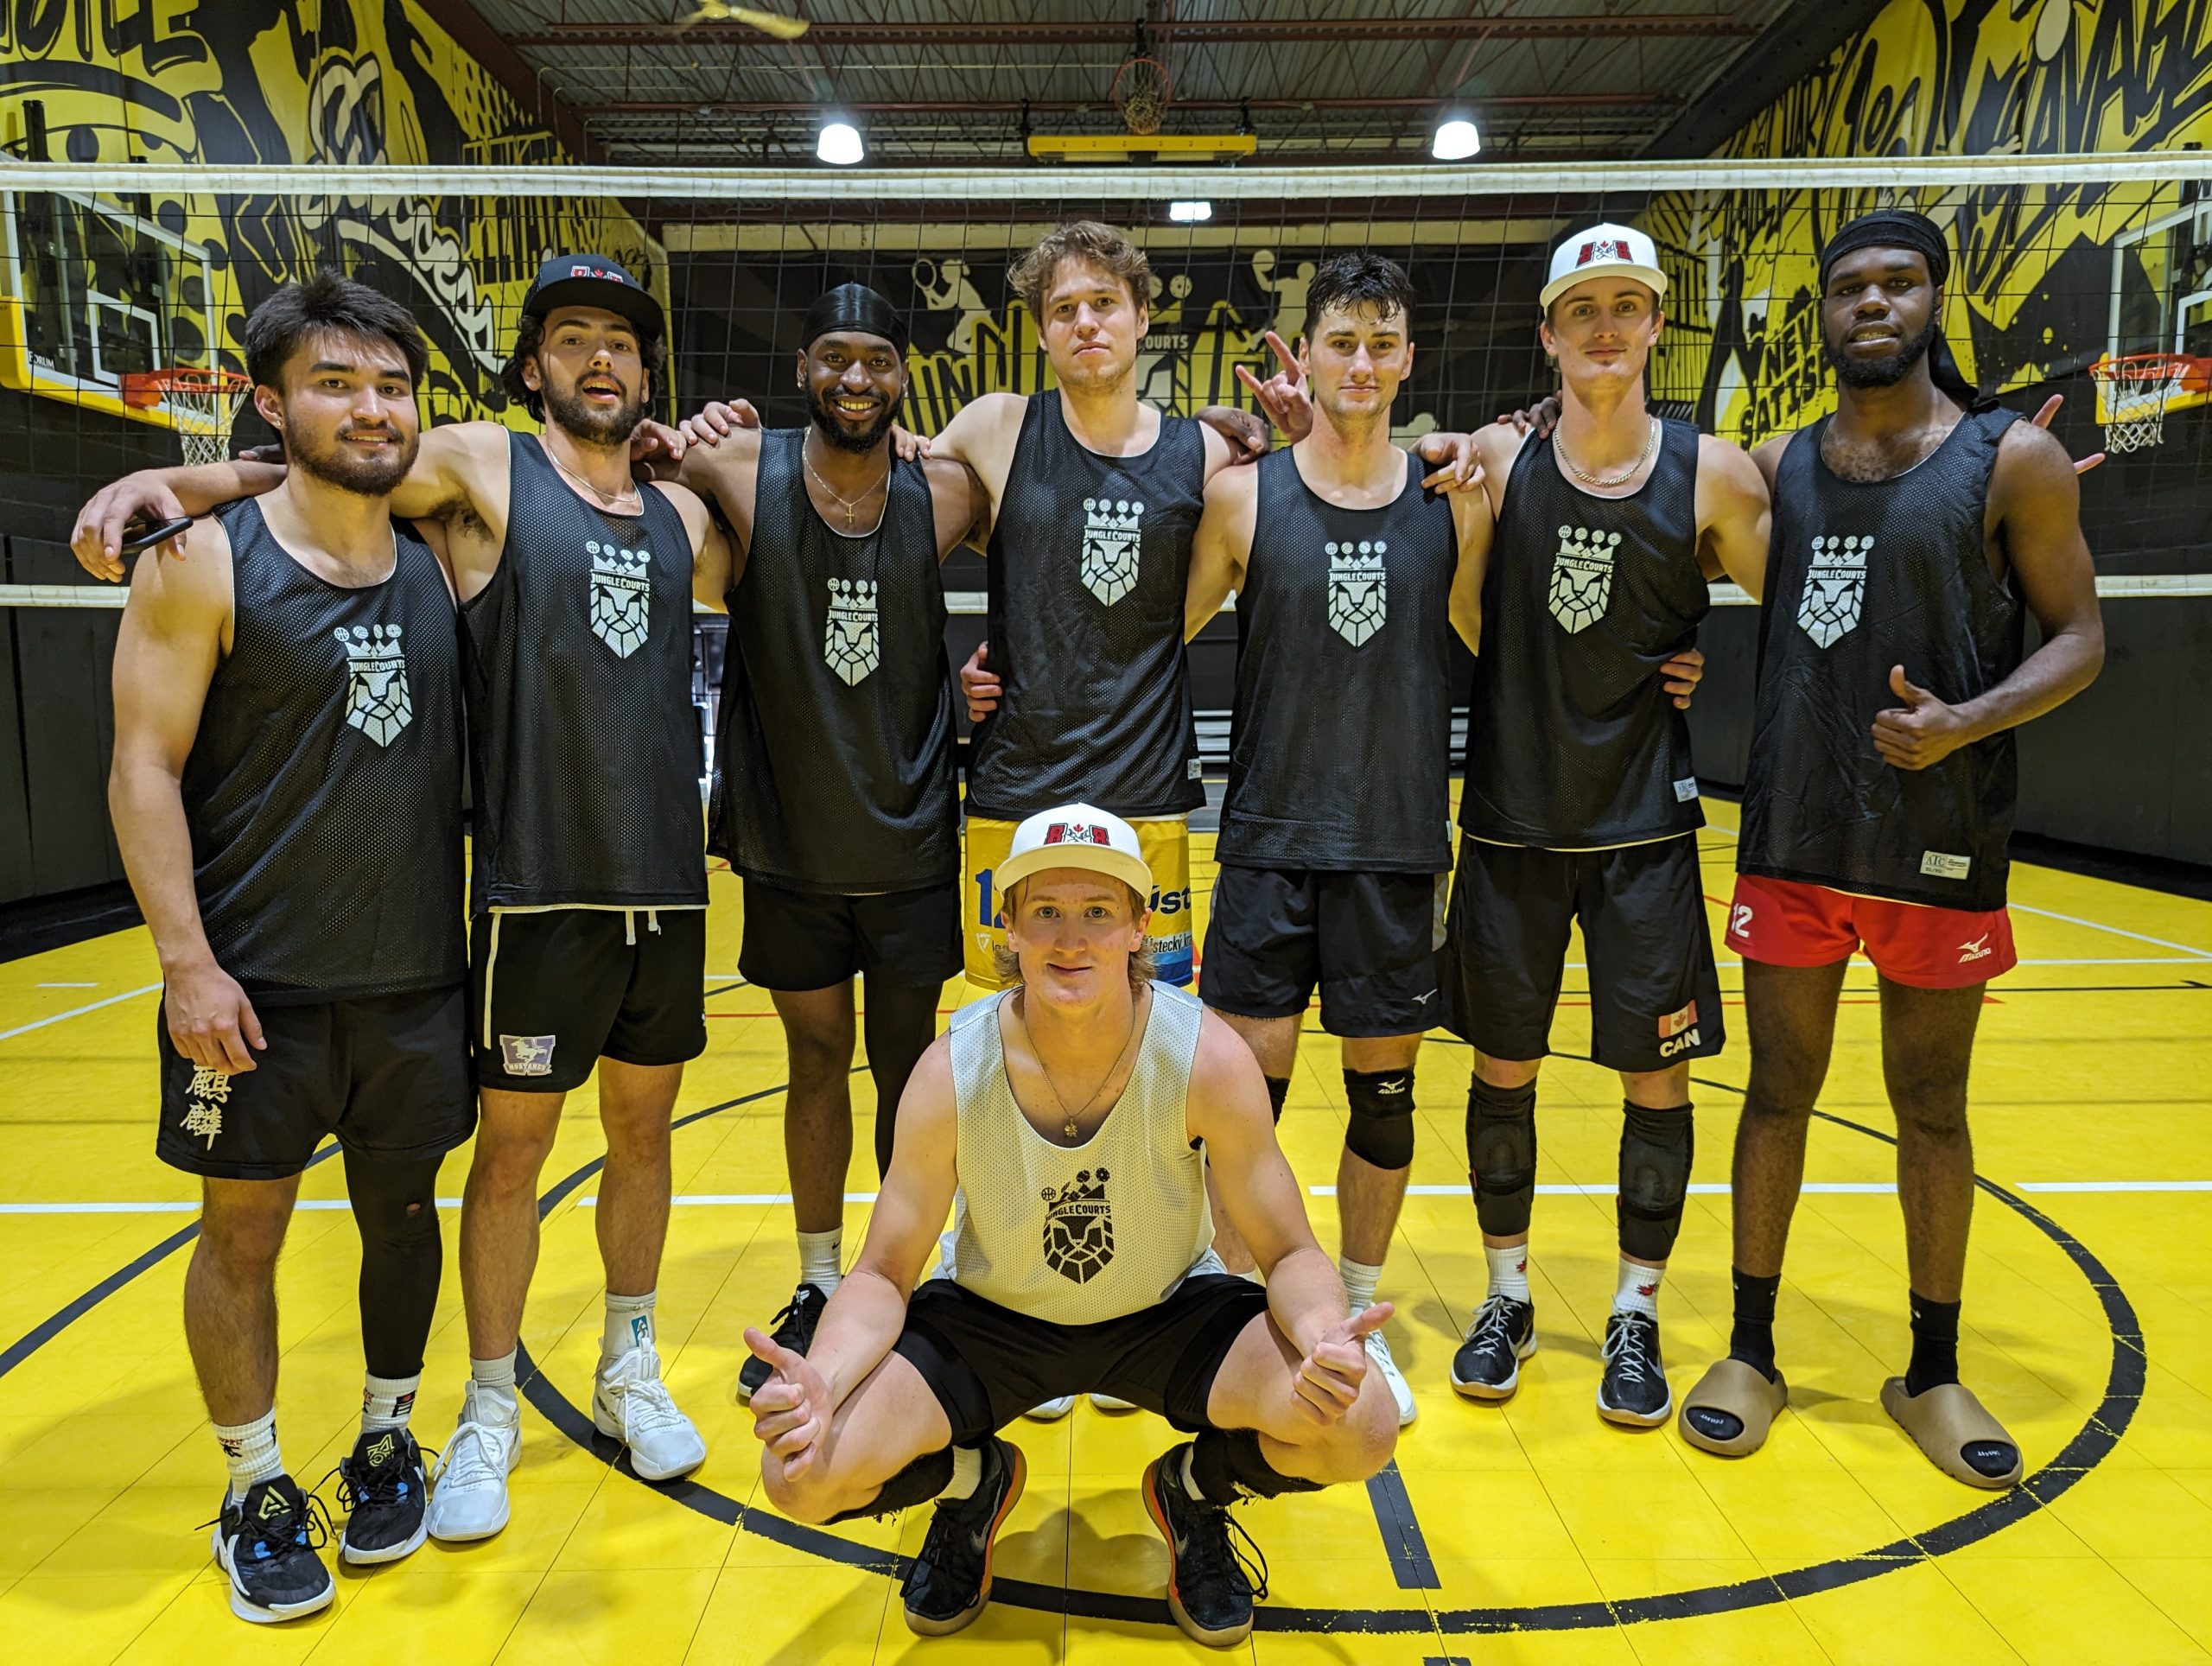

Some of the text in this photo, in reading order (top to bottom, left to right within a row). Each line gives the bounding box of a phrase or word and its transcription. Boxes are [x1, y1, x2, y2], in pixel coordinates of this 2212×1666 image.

[29, 350, 55, 369] FORUM
[976, 868, 1007, 929] 1
[1660, 1028, 1701, 1058] CAN
